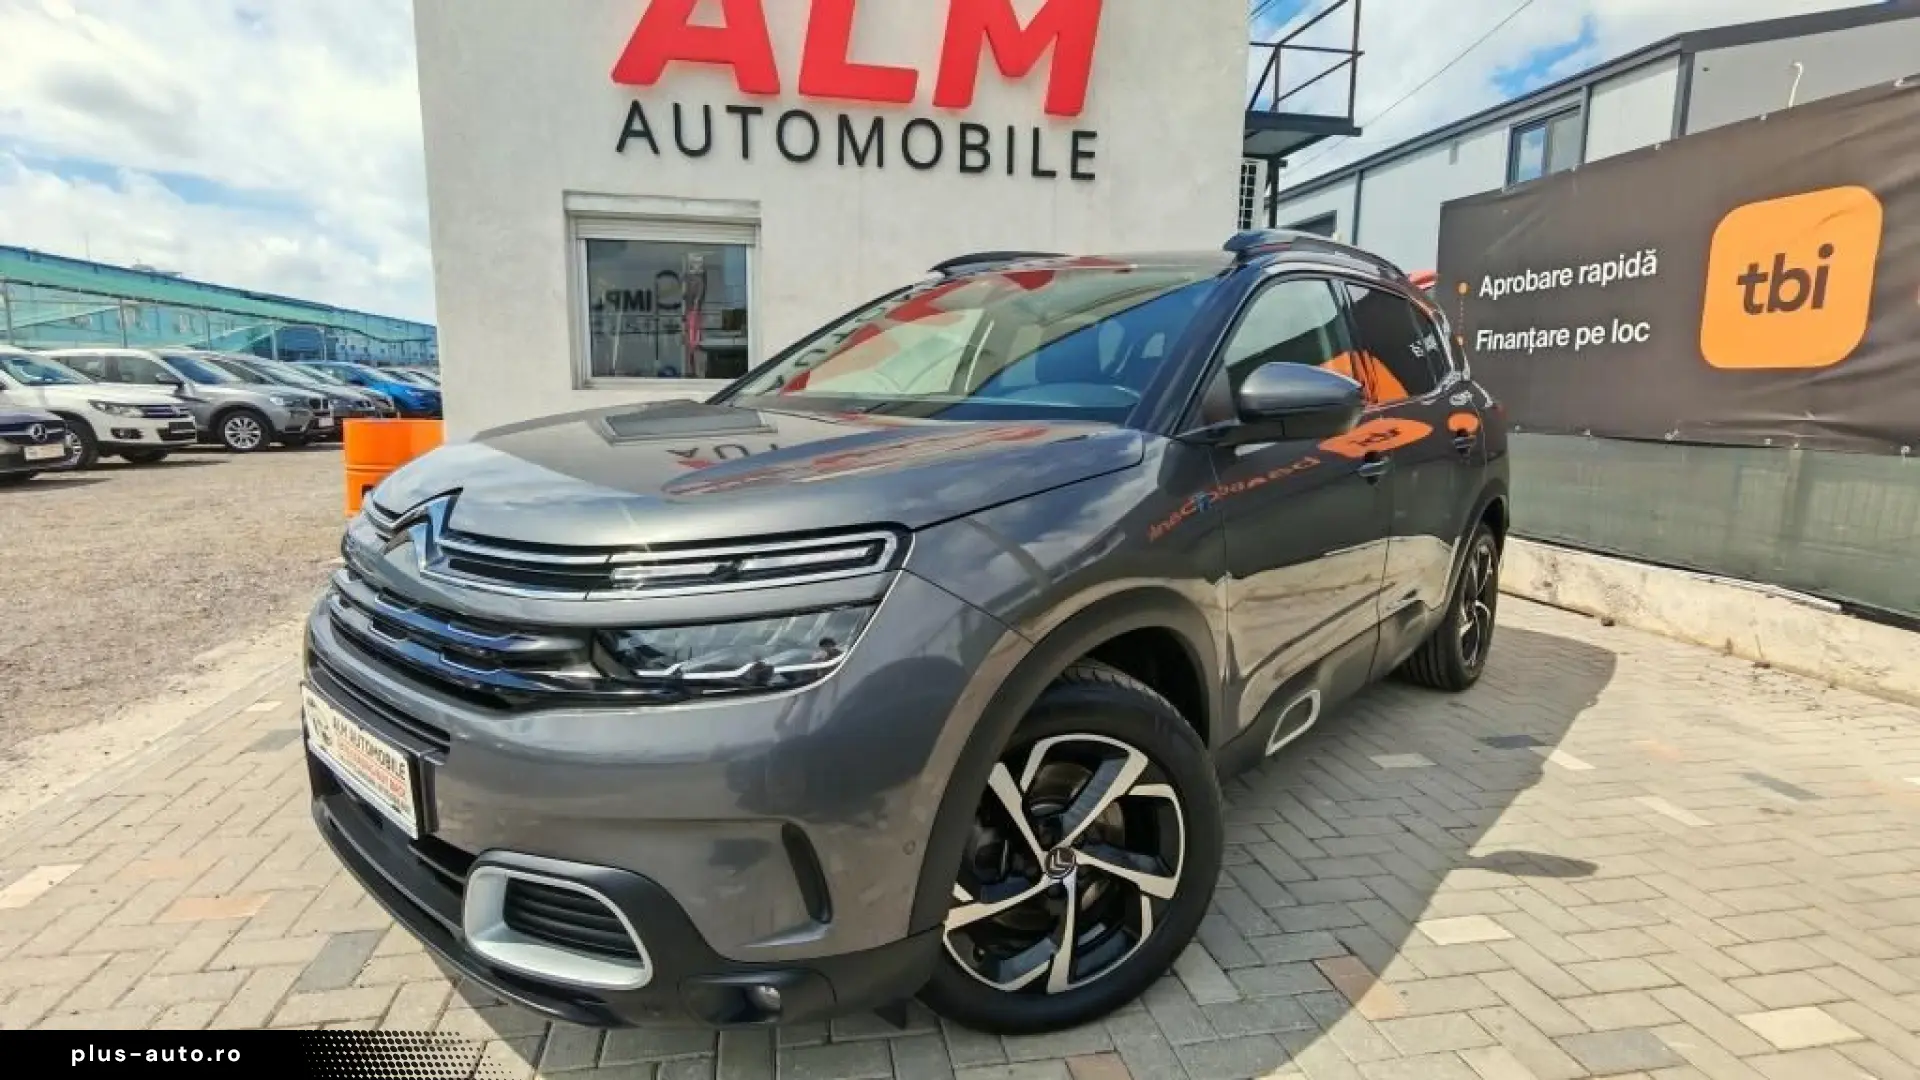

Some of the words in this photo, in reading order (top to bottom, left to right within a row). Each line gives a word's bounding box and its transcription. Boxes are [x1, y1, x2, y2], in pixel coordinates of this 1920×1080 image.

[611, 0, 1102, 117] ALM
[615, 100, 1098, 181] AUTOMOBILE
[1478, 267, 1574, 301] Aprobare
[1578, 248, 1658, 288] rapidă
[1736, 243, 1836, 316] tbi
[1475, 326, 1571, 355] Finanțare
[1574, 323, 1606, 352] pe
[1611, 318, 1651, 345] loc
